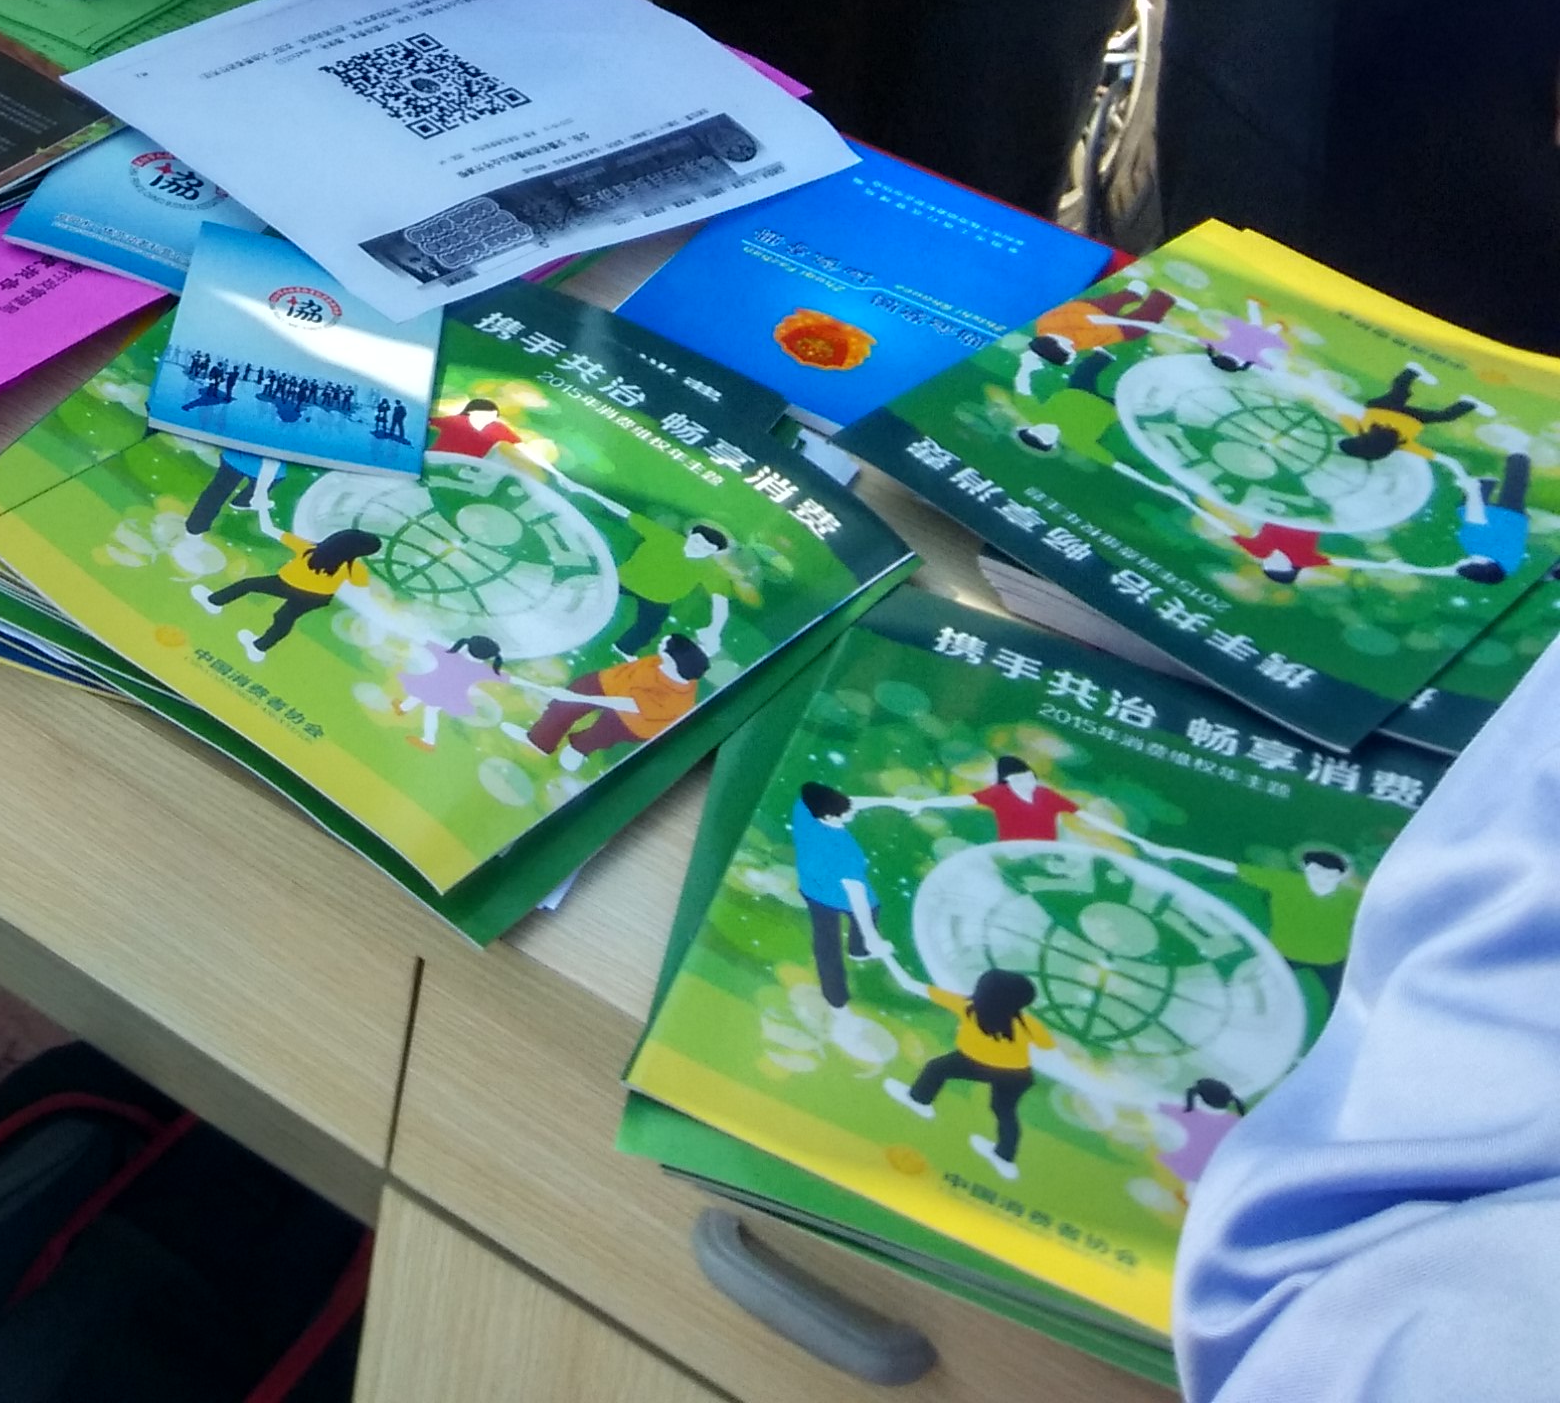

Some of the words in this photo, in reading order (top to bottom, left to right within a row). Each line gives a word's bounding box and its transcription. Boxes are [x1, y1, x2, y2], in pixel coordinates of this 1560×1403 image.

[473, 312, 647, 409] 携手共治
[660, 410, 843, 541] 畅享消费
[536, 370, 725, 488] 2015年消费维权年主题
[906, 435, 1094, 563] 畅享消费
[1110, 568, 1318, 691] 携手共治
[195, 648, 325, 739] 中国消费者协会
[934, 626, 1158, 730] 携手共治
[1186, 715, 1426, 811] 畅享消费
[1039, 701, 1292, 800] 2015年消费维权年主题
